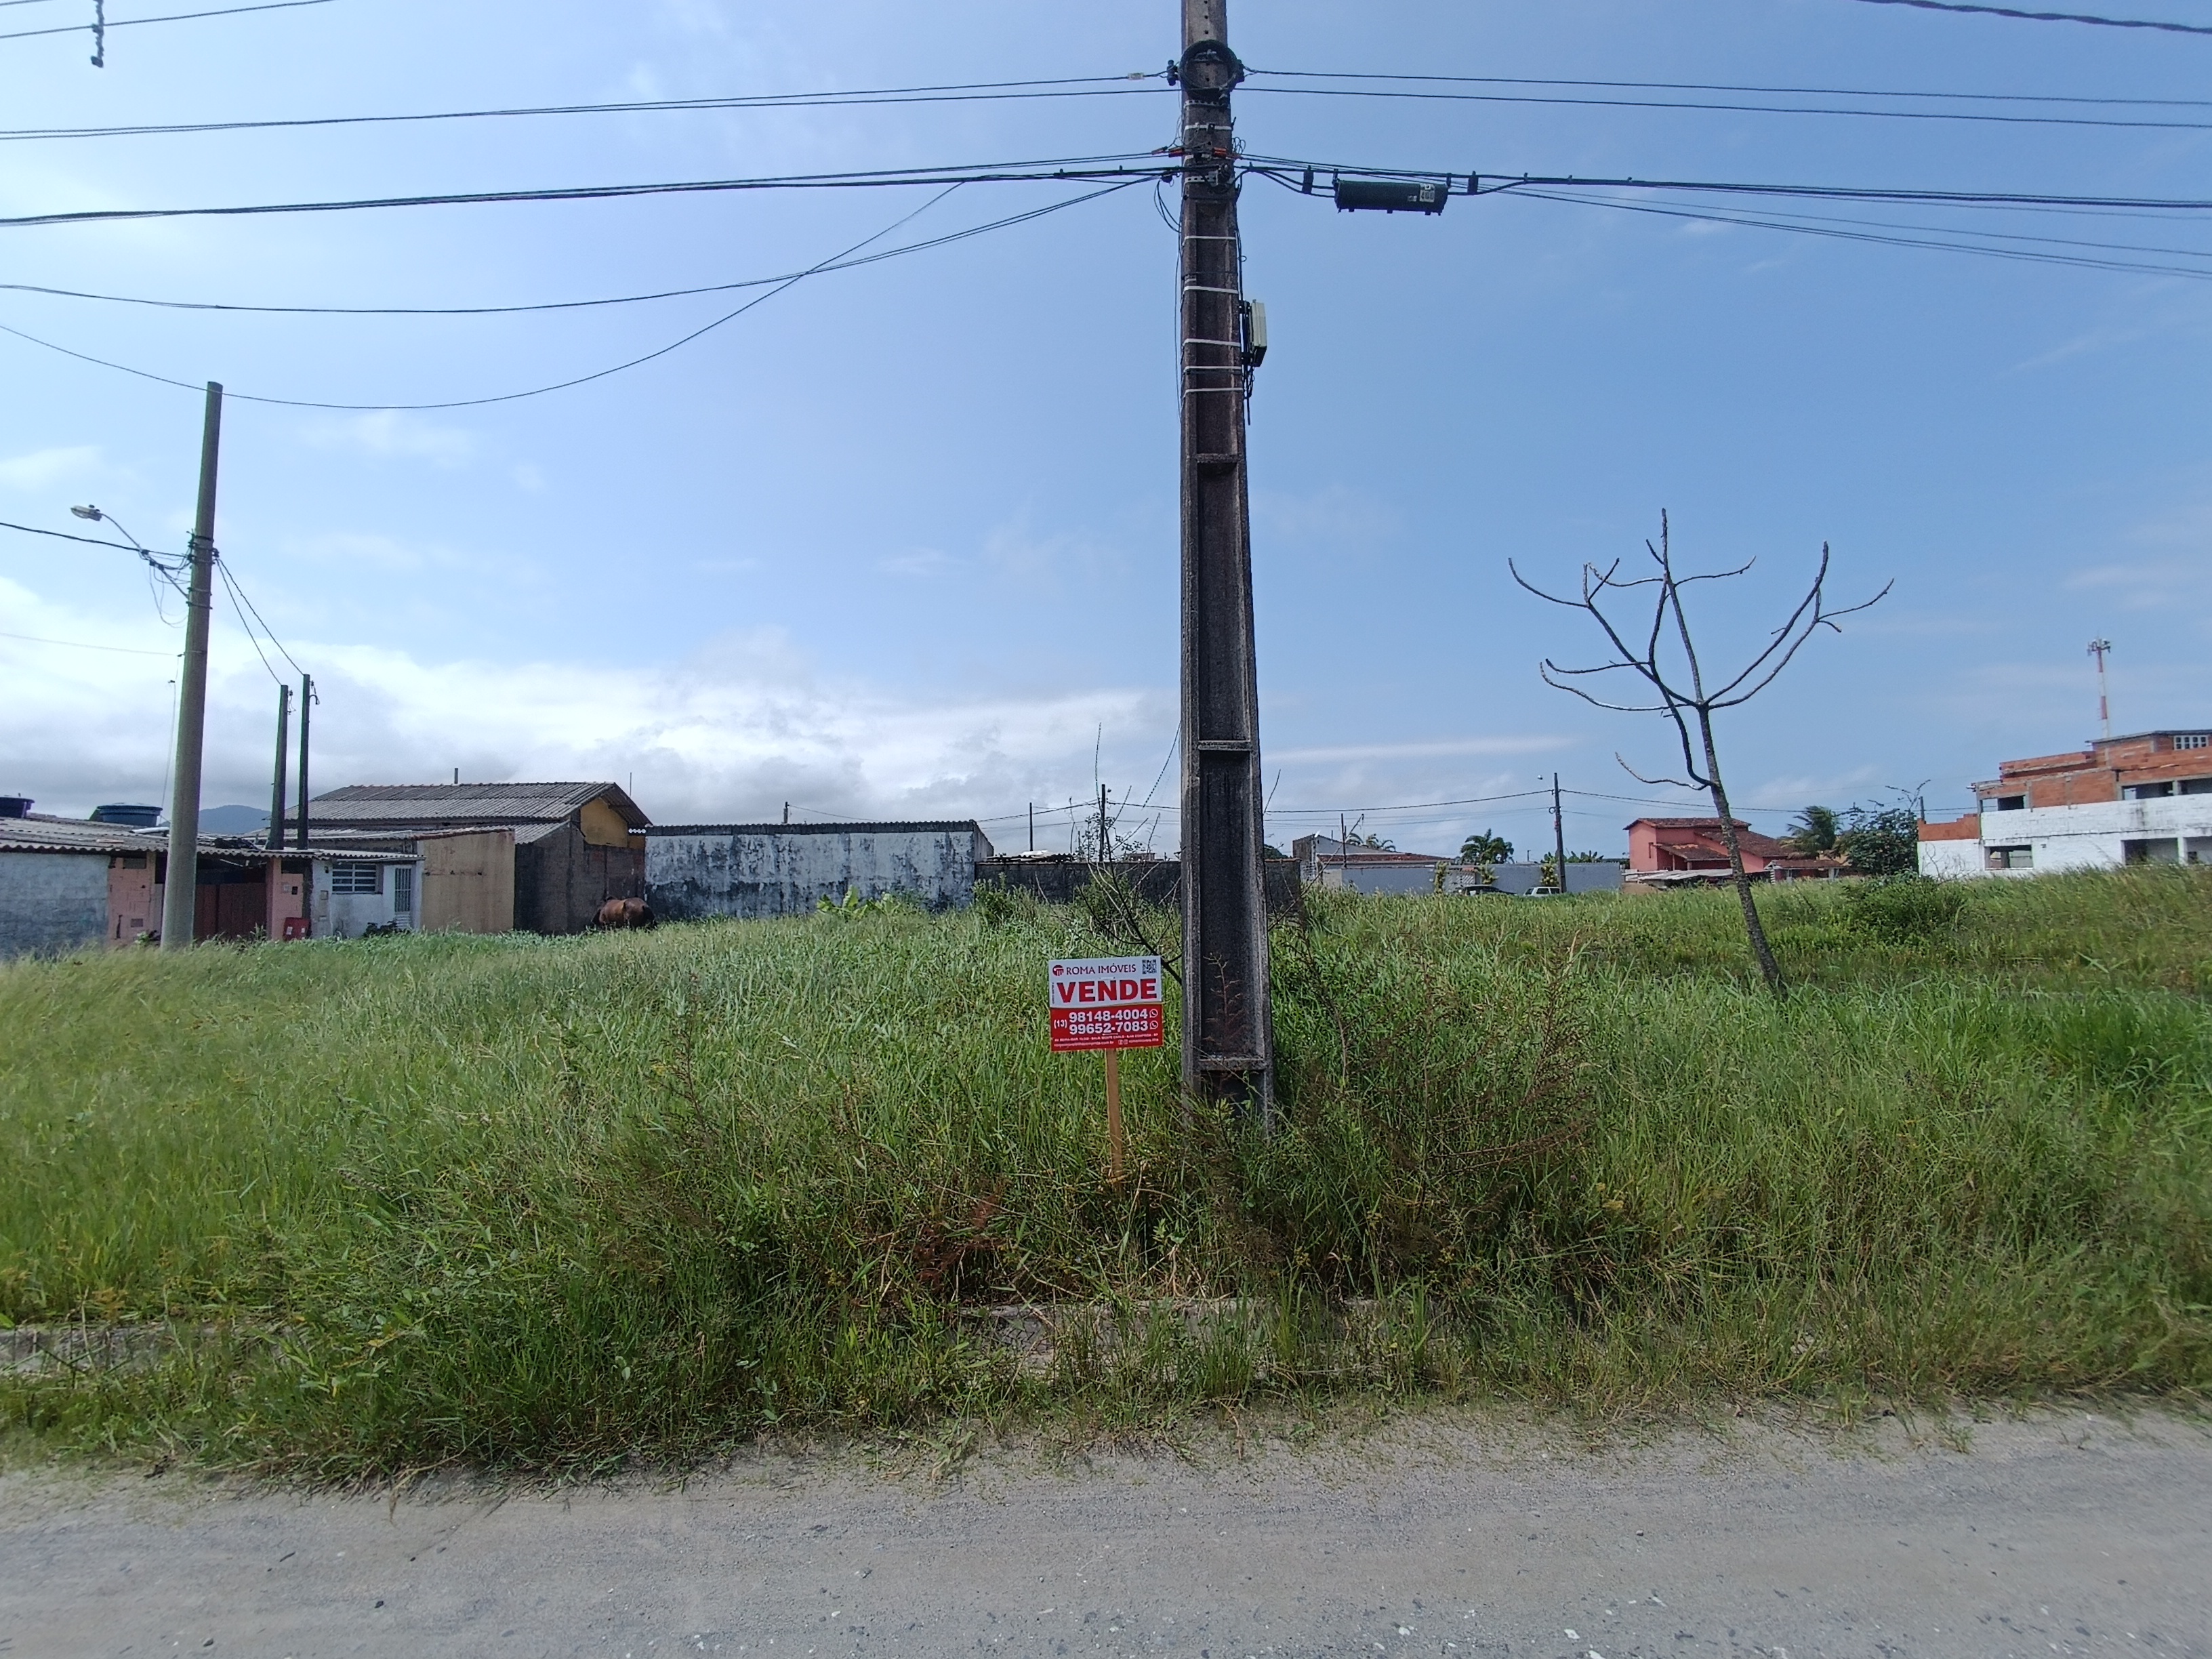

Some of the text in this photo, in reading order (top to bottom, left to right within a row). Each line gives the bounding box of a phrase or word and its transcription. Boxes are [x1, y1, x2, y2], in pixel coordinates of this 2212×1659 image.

[1066, 963, 1136, 975] ROMA IMÓVEIS
[1057, 979, 1157, 1003] VENDE
[1069, 1008, 1148, 1023] 98148-4004
[1054, 1019, 1067, 1029] (13)
[1069, 1021, 1149, 1034] 99652-7083
